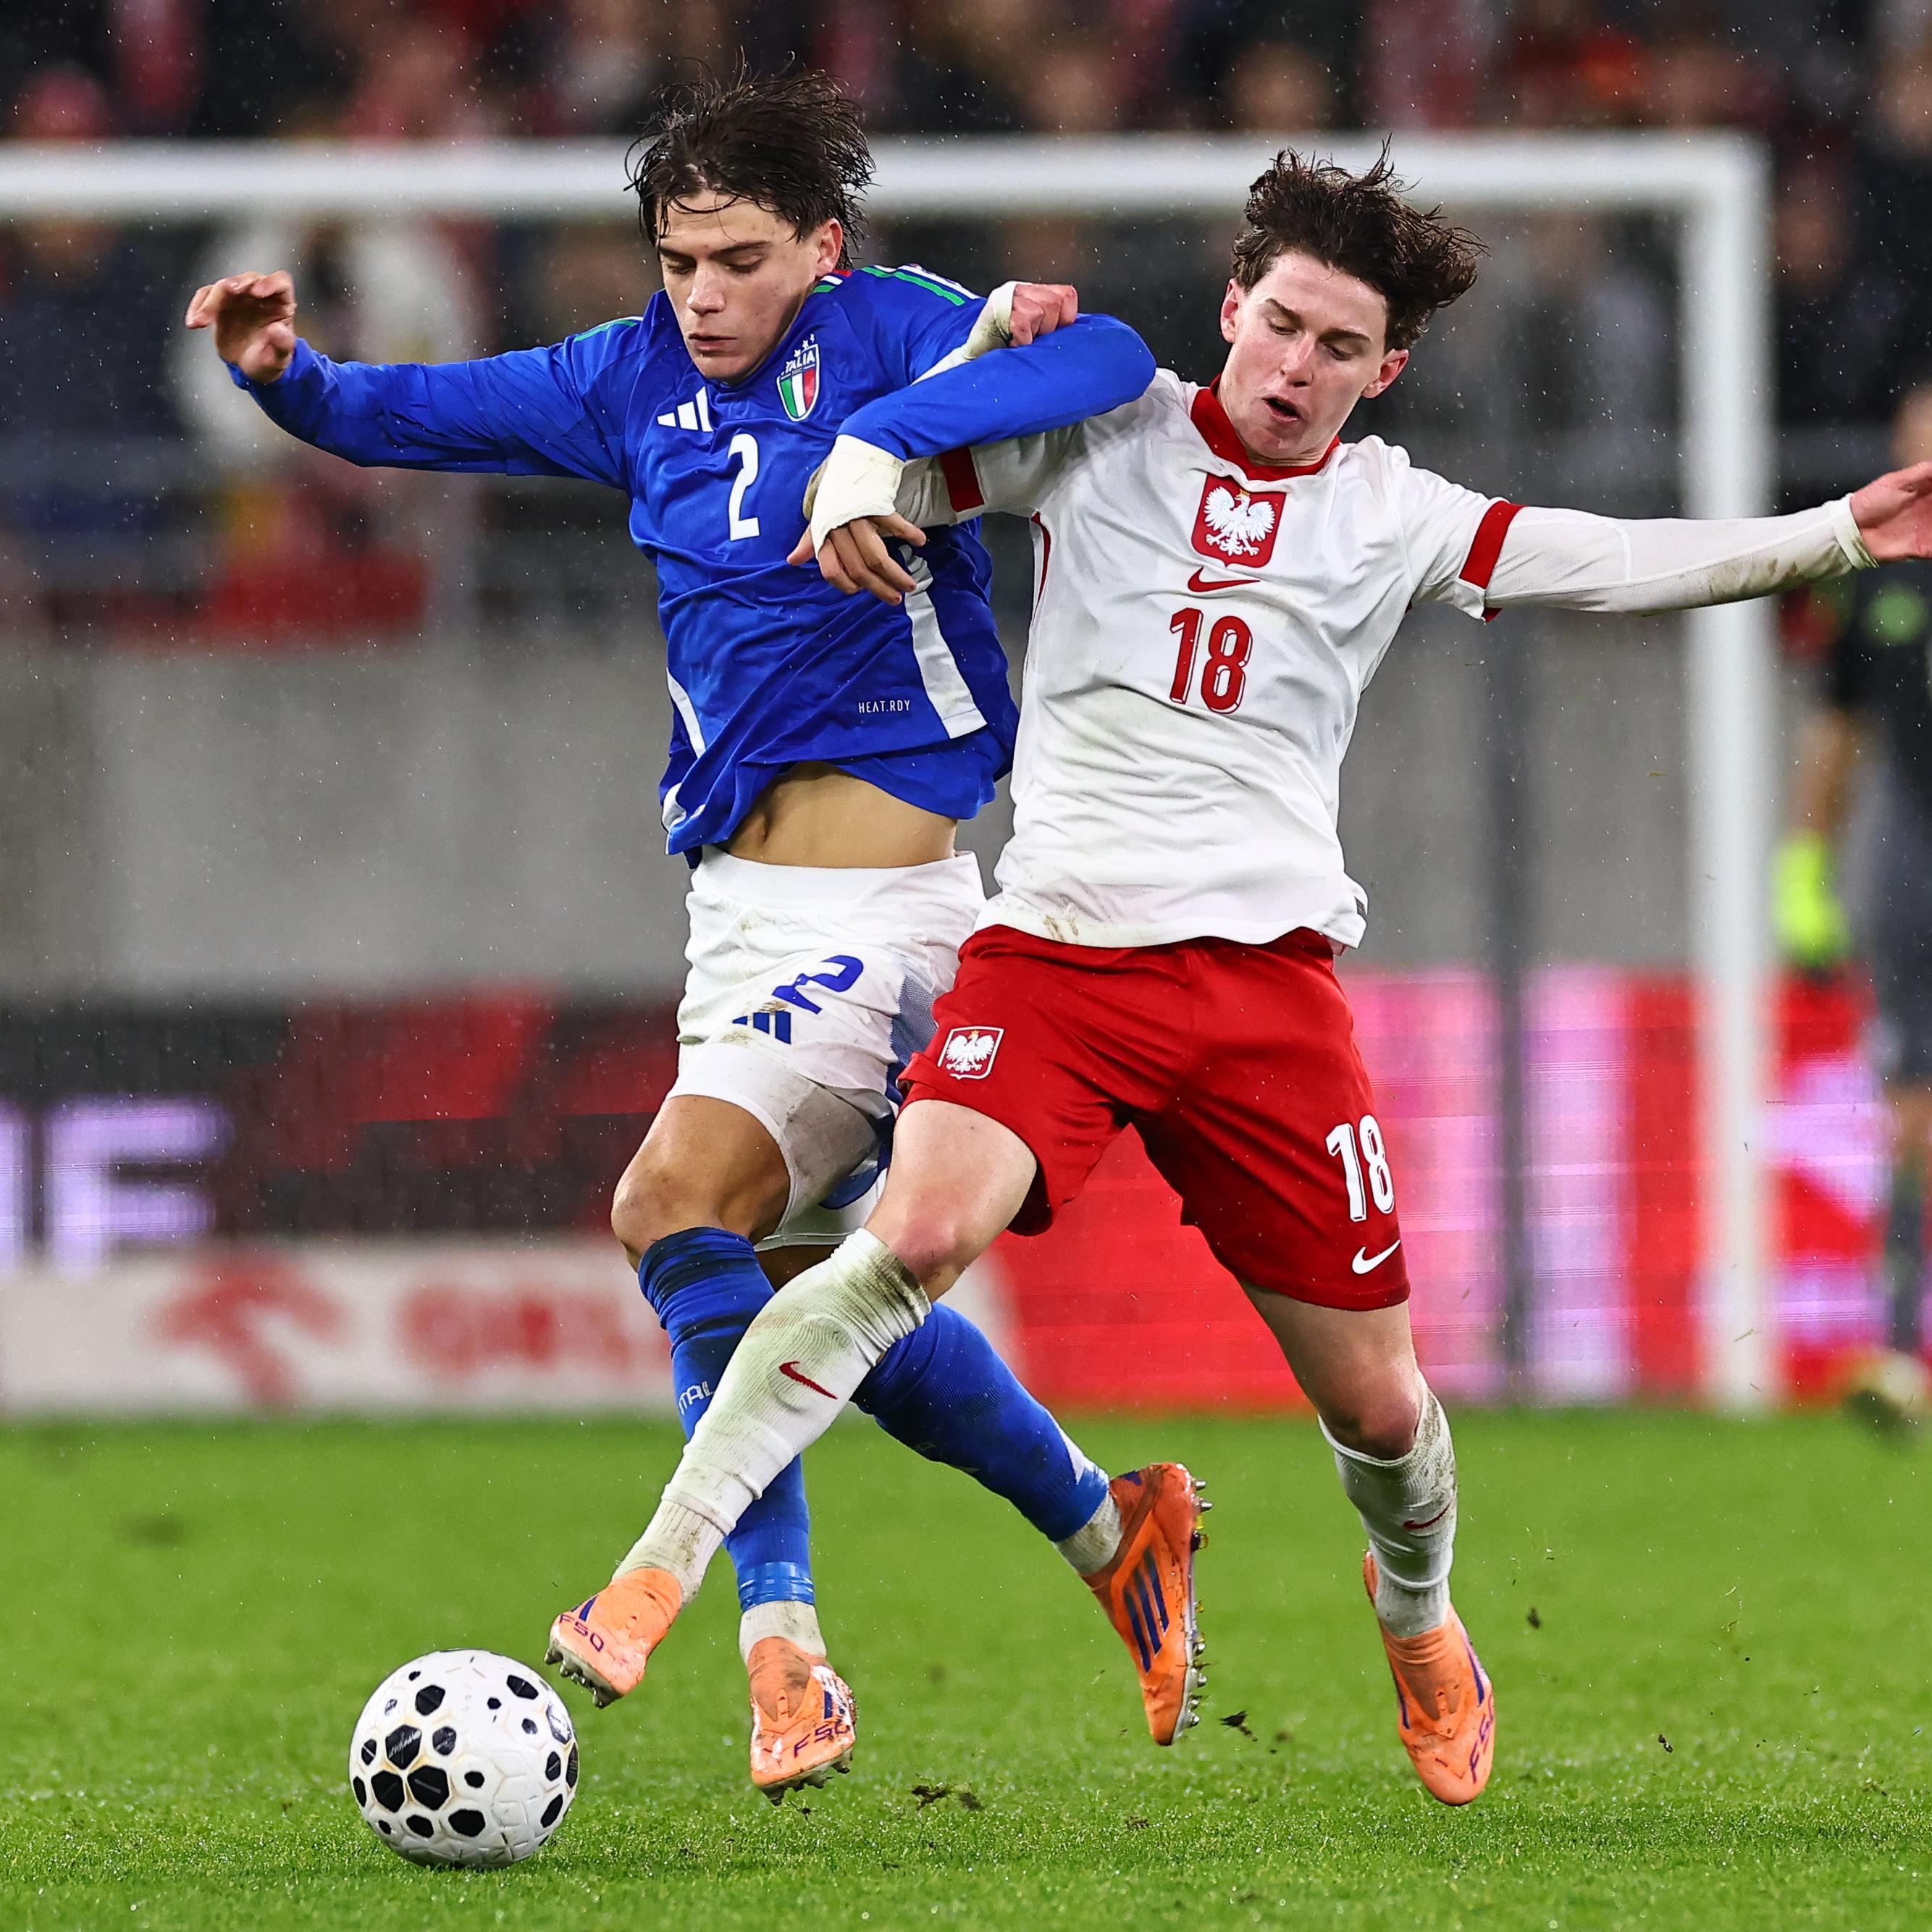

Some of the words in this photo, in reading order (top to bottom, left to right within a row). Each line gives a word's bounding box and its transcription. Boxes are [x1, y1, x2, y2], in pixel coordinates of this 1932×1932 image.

[728, 433, 760, 541] 2
[858, 700, 910, 714] HEAT.RDY
[1169, 607, 1253, 714] 18
[771, 954, 864, 1015] 2
[1325, 1114, 1395, 1222] 18
